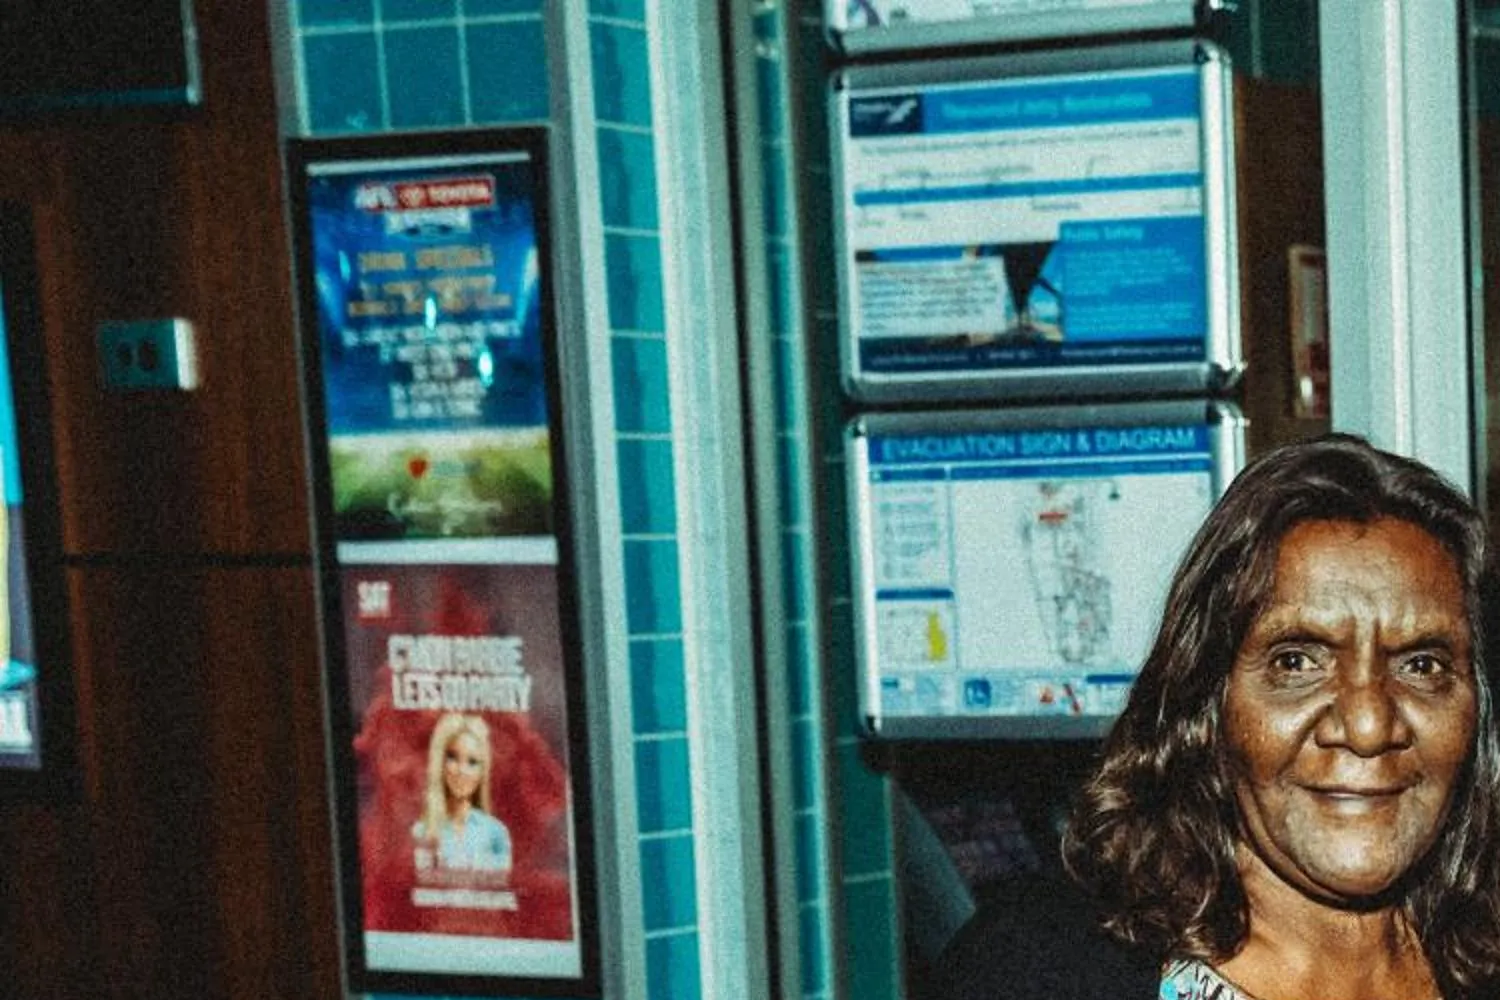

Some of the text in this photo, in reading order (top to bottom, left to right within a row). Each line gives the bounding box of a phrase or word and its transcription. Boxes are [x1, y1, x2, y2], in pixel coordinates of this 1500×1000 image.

[880, 428, 1196, 460] EVACUATION SIGN & DIAGRAM
